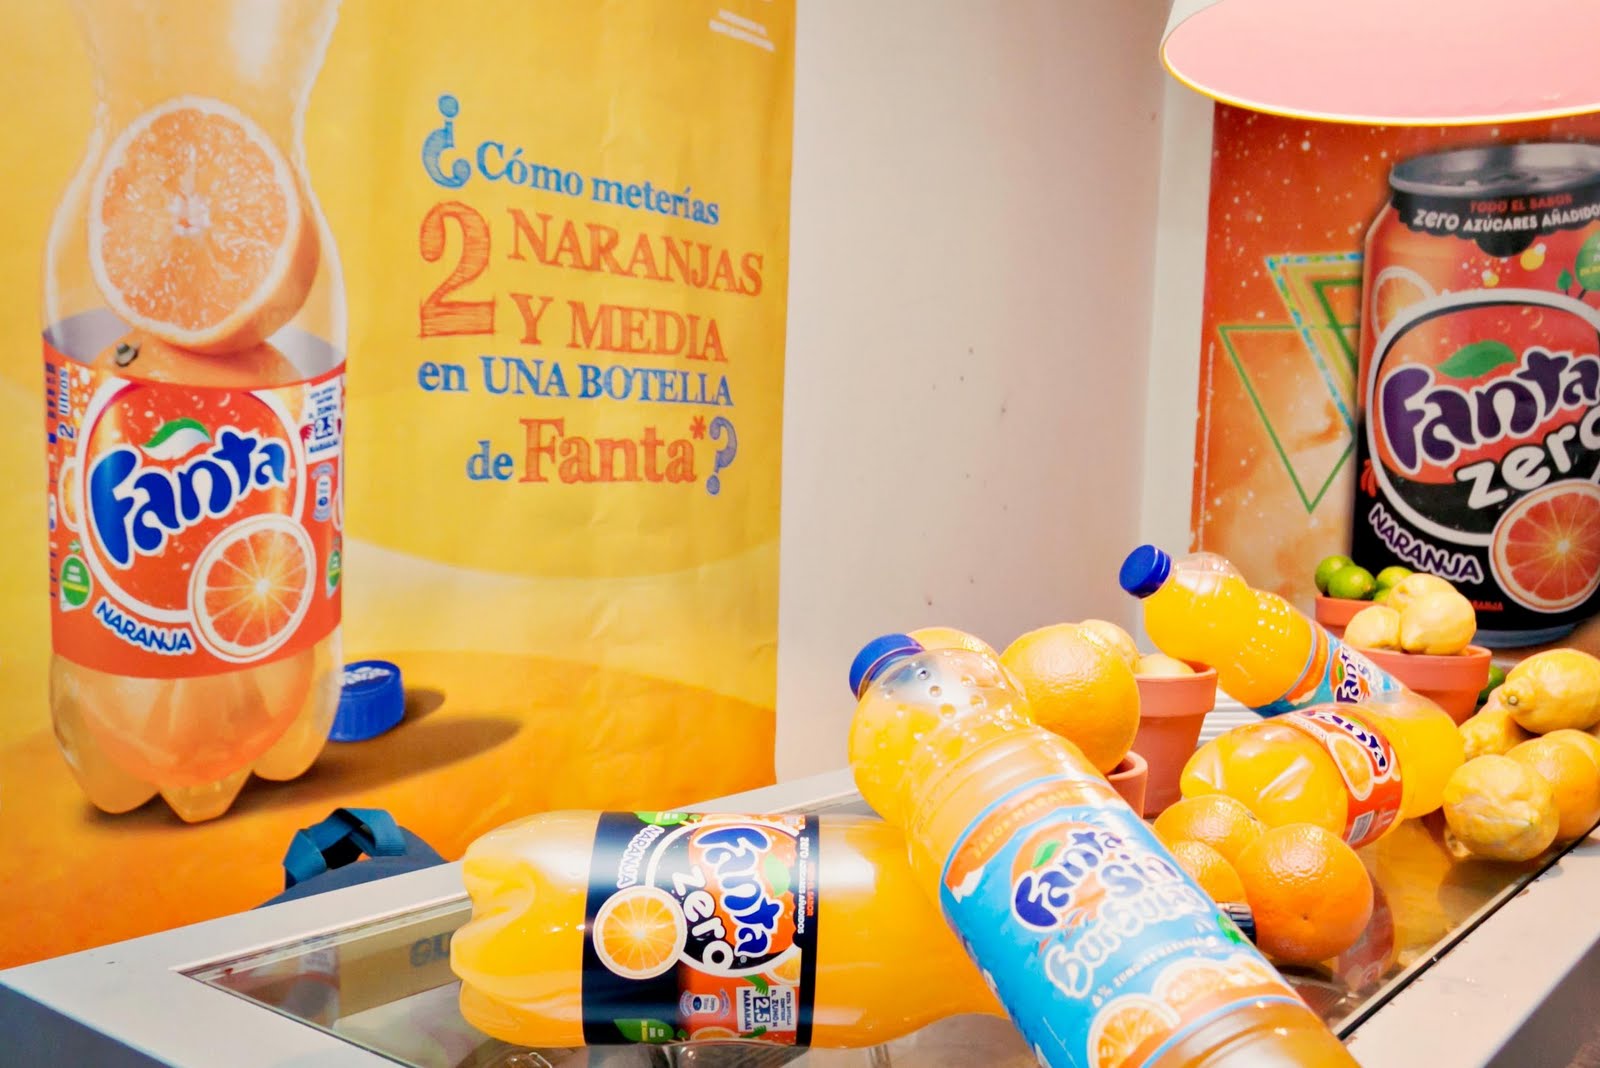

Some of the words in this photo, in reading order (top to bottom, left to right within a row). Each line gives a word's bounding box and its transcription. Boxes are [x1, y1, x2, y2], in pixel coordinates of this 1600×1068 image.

[590, 176, 721, 226] meterías
[1413, 208, 1460, 231] zero
[1462, 213, 1538, 233] AZÚCARES
[1540, 201, 1600, 228] AÑADIDO
[1470, 199, 1508, 214] TODO
[1510, 198, 1526, 212] EL
[418, 200, 496, 339] 2
[506, 207, 766, 297] NARANJAS
[509, 292, 554, 346] Y
[566, 299, 730, 364] MEDIA
[417, 360, 469, 393] en
[479, 355, 571, 399] UNA
[576, 363, 735, 408] BOTELLA
[1380, 349, 1600, 473] Fanta
[466, 439, 514, 481] de
[89, 428, 288, 567] Fanta
[1370, 505, 1483, 583] NARANJA
[94, 600, 194, 652] NARANJA
[617, 825, 664, 889] NARANJA
[1013, 830, 1123, 928] Fanta
[671, 866, 734, 972] zero
[694, 826, 781, 957] Fanta
[743, 989, 752, 1031] NARANJAS
[753, 997, 770, 1023] 2,5
[771, 999, 780, 1021] ZUMO
